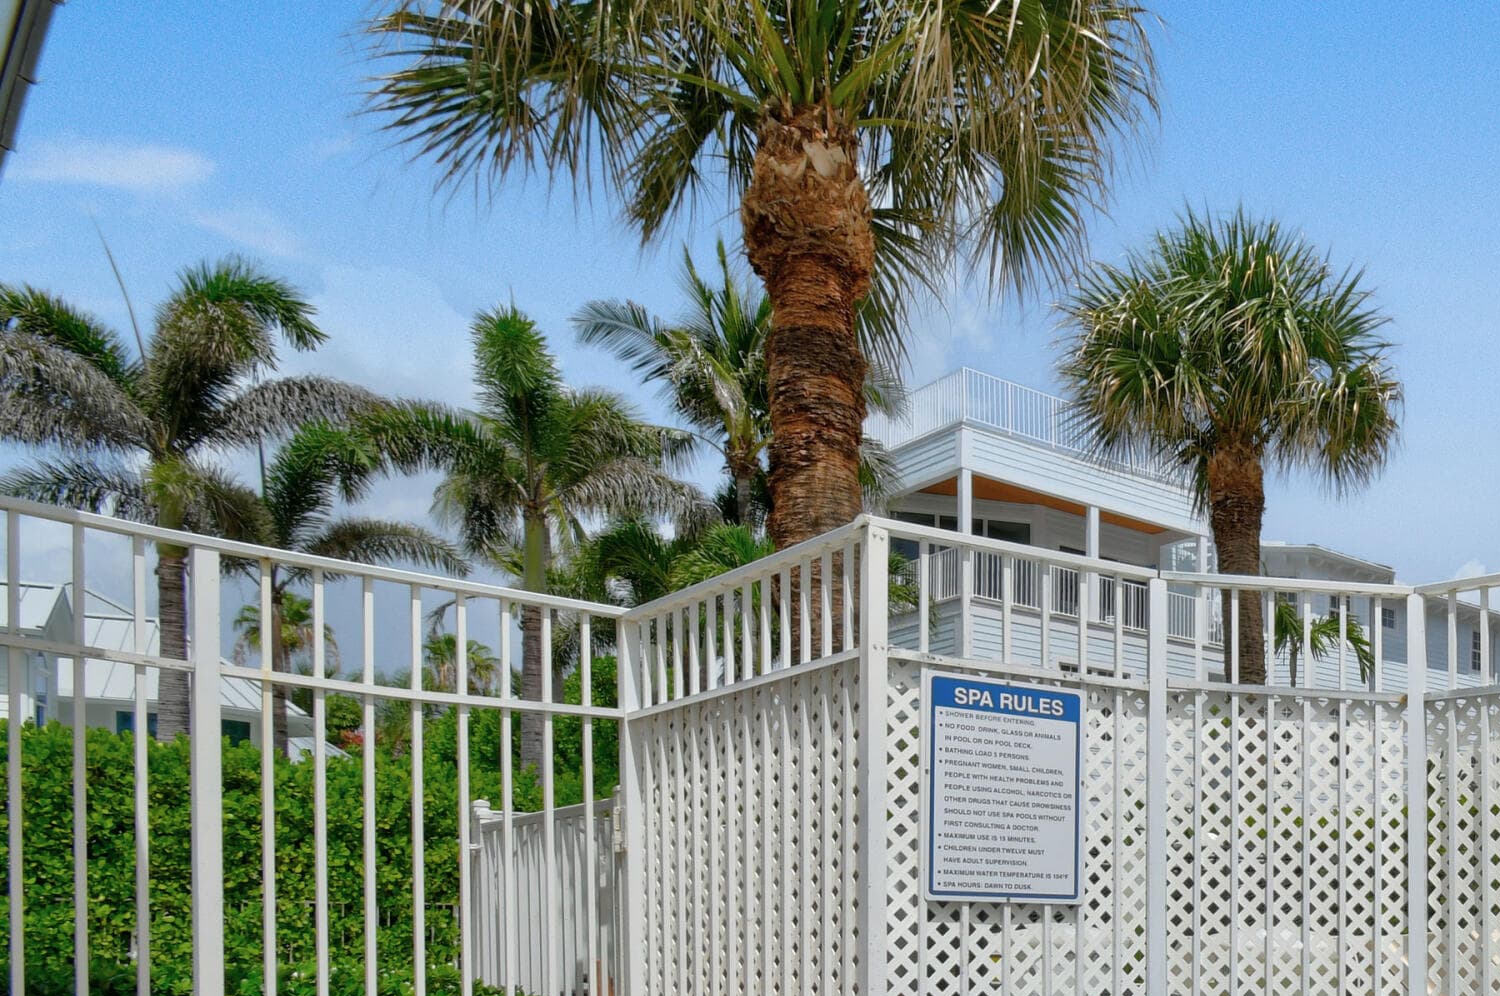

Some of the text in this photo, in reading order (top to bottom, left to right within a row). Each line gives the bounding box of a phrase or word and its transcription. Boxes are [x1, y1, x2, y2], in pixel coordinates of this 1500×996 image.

[954, 686, 1064, 715] SPA RULES
[944, 710, 974, 719] SHOWER
[974, 713, 1002, 722] BEFORE
[1000, 728, 1023, 736] GLASS
[1033, 731, 1061, 740] ANIMALS
[952, 735, 971, 743] POOL
[994, 739, 1012, 747] POOL
[944, 746, 973, 755] BATHING
[974, 749, 992, 757] LOAD
[944, 758, 980, 768] PREGNANT
[1008, 764, 1030, 772] SMALL
[943, 770, 970, 779] PEOPLE
[989, 774, 1014, 783] HEALTH
[1015, 777, 1049, 786] PROBLEMS
[943, 782, 970, 791] PEOPLE
[971, 785, 992, 793] USING
[1026, 789, 1061, 798] NARCOTICS
[943, 795, 1071, 811] OTHER DRUGS THAT CAUSE DROWSINESS
[943, 807, 971, 815] SHOULD
[1015, 812, 1037, 820] POOLS
[1037, 814, 1065, 822] WITHOUT
[963, 820, 1005, 829] CONSULTING
[943, 831, 975, 840] MAXIMUM
[942, 843, 1045, 856] CHILDREN UNDER TWELVE MUST
[943, 855, 961, 863] HAVE
[942, 867, 975, 875] MAXIMUM
[999, 870, 1044, 879] TEMPERATURE
